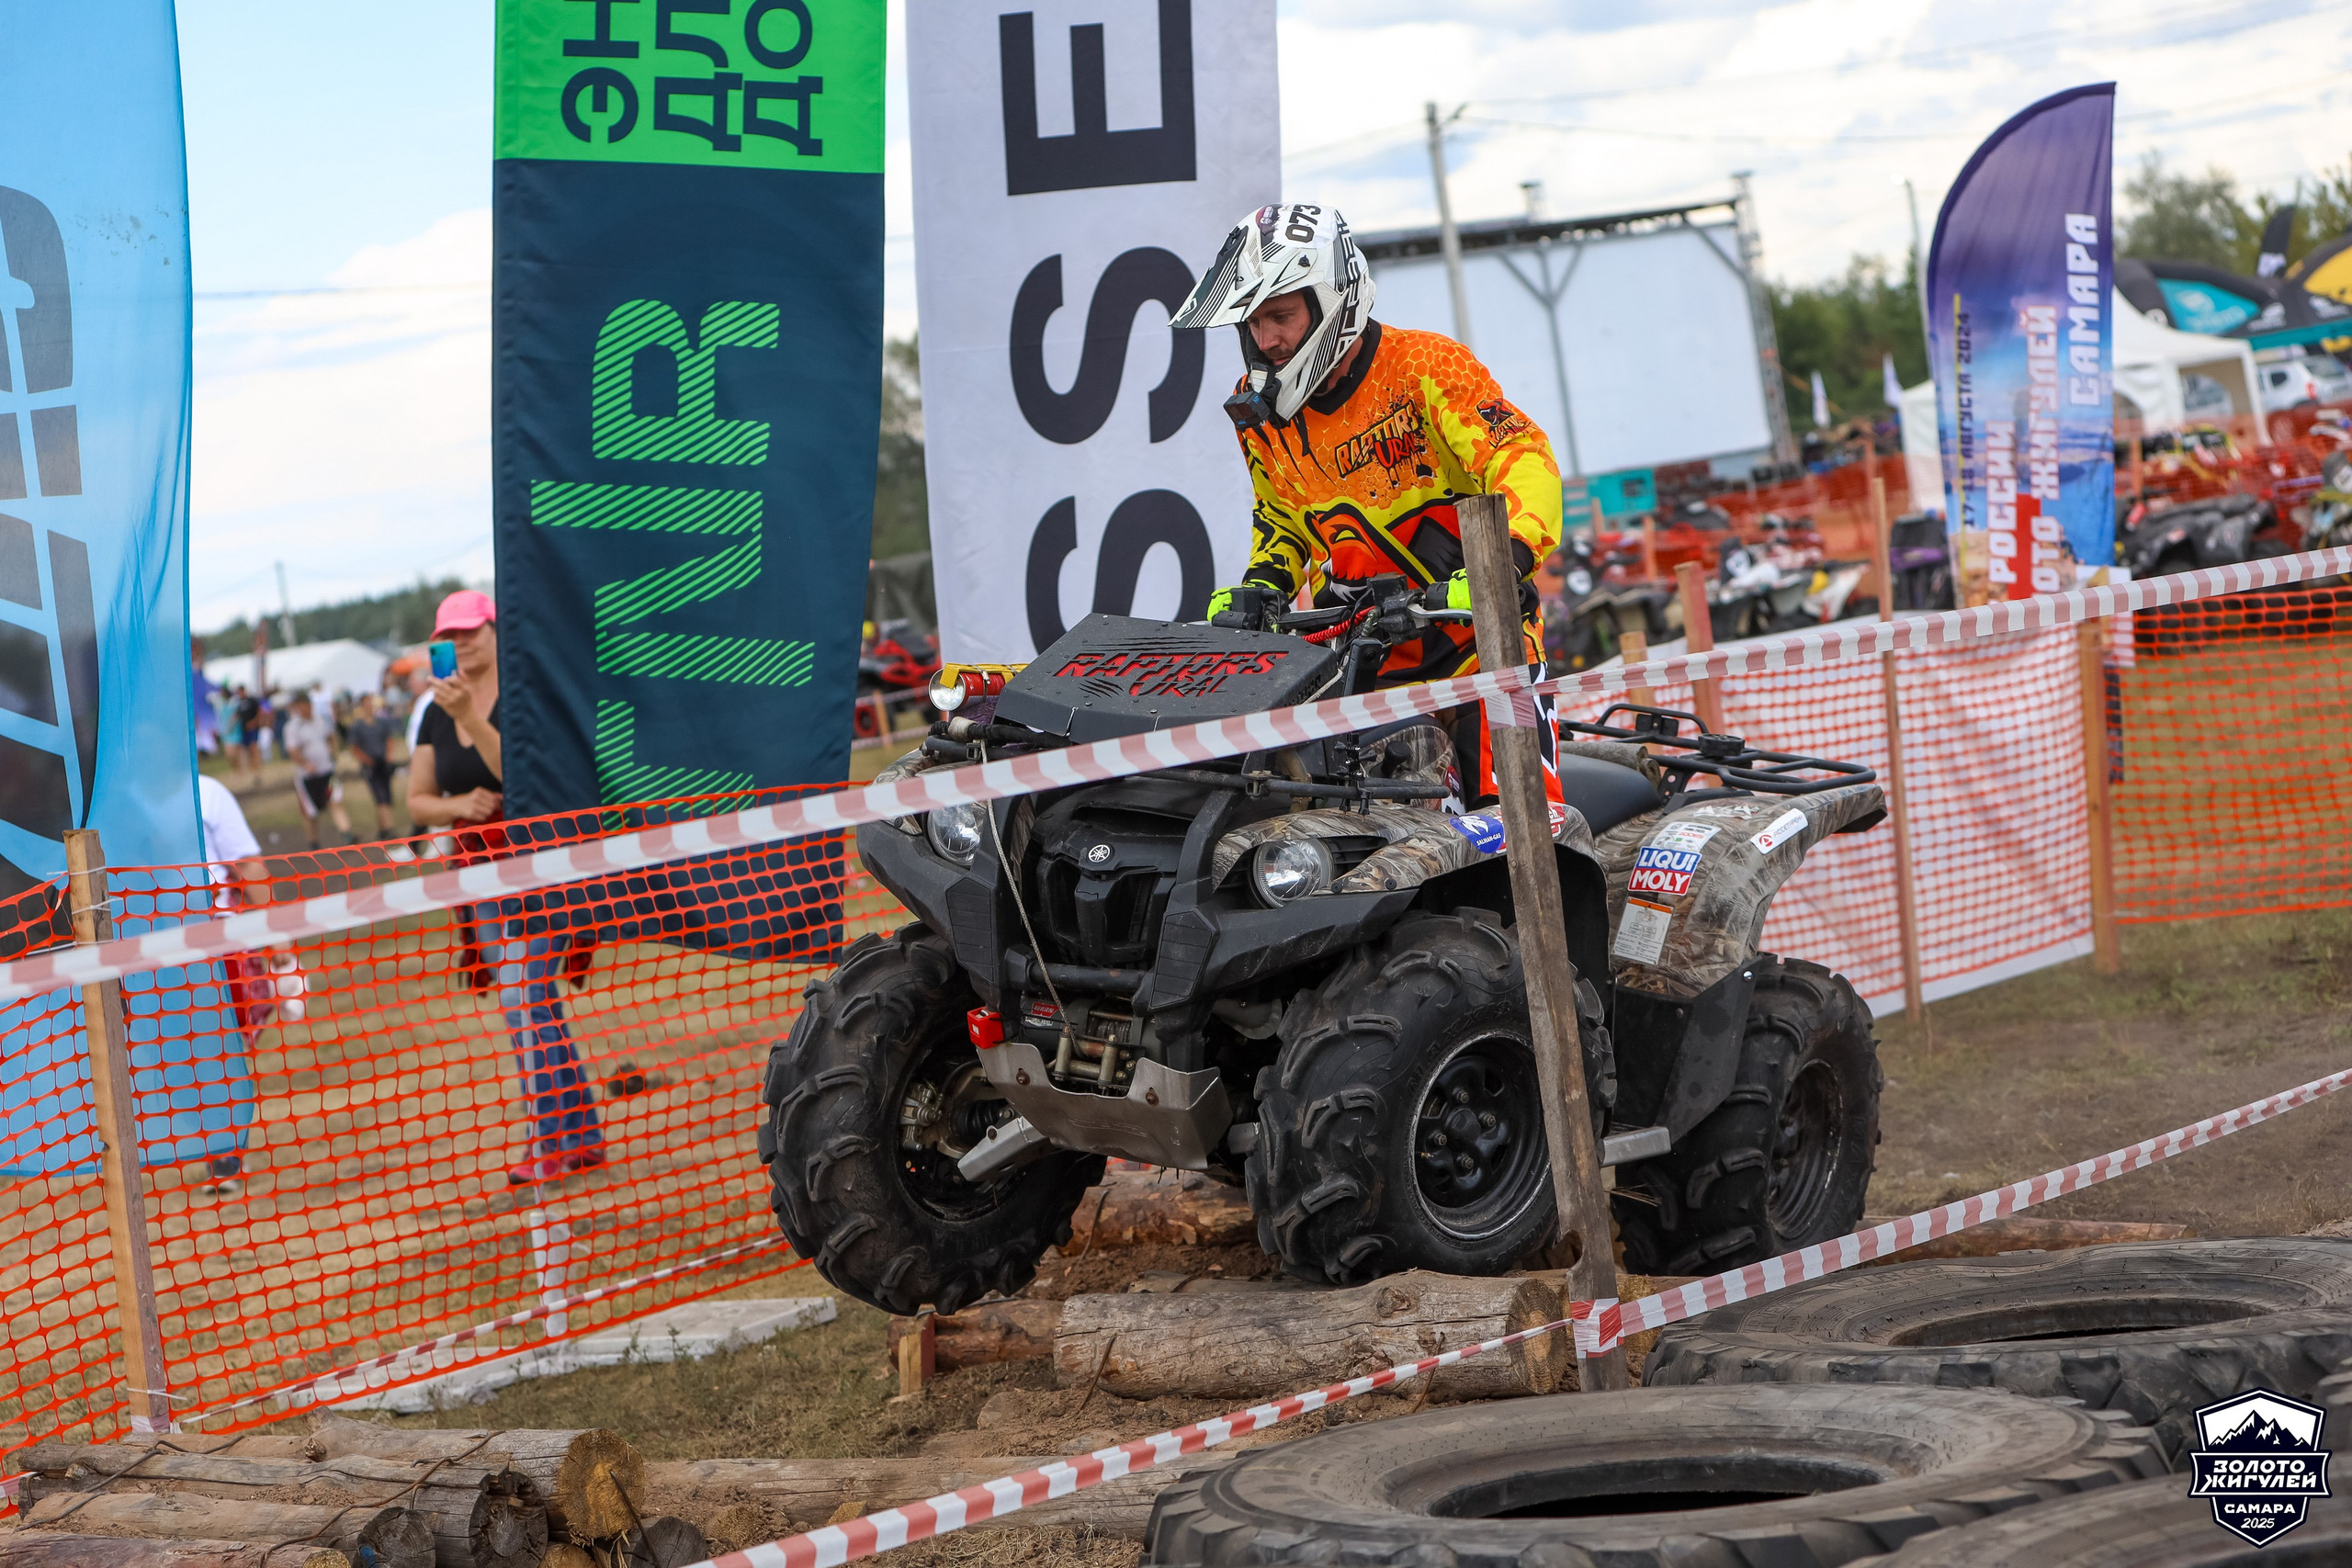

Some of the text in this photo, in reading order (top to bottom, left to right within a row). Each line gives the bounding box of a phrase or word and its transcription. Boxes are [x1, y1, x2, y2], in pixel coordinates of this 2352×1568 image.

[1284, 204, 1322, 243] 073
[2064, 212, 2099, 405] САМАРА
[1957, 312, 1973, 364] 2024
[1958, 371, 1974, 458] АВГУСТА
[1336, 400, 1420, 477] RAPTORS
[1374, 432, 1419, 468] URAL
[2019, 305, 2061, 599] ОТО ЖИГУЛЕЙ
[1985, 420, 2018, 583] РОССИИ
[1052, 650, 1290, 678] RAPTORS
[1128, 673, 1228, 697] URAL
[1476, 833, 1502, 847] SALMAN-GAS
[1636, 849, 1700, 872] LIQUI
[1631, 869, 1691, 894] MOLY
[1034, 1005, 1055, 1015] WARN
